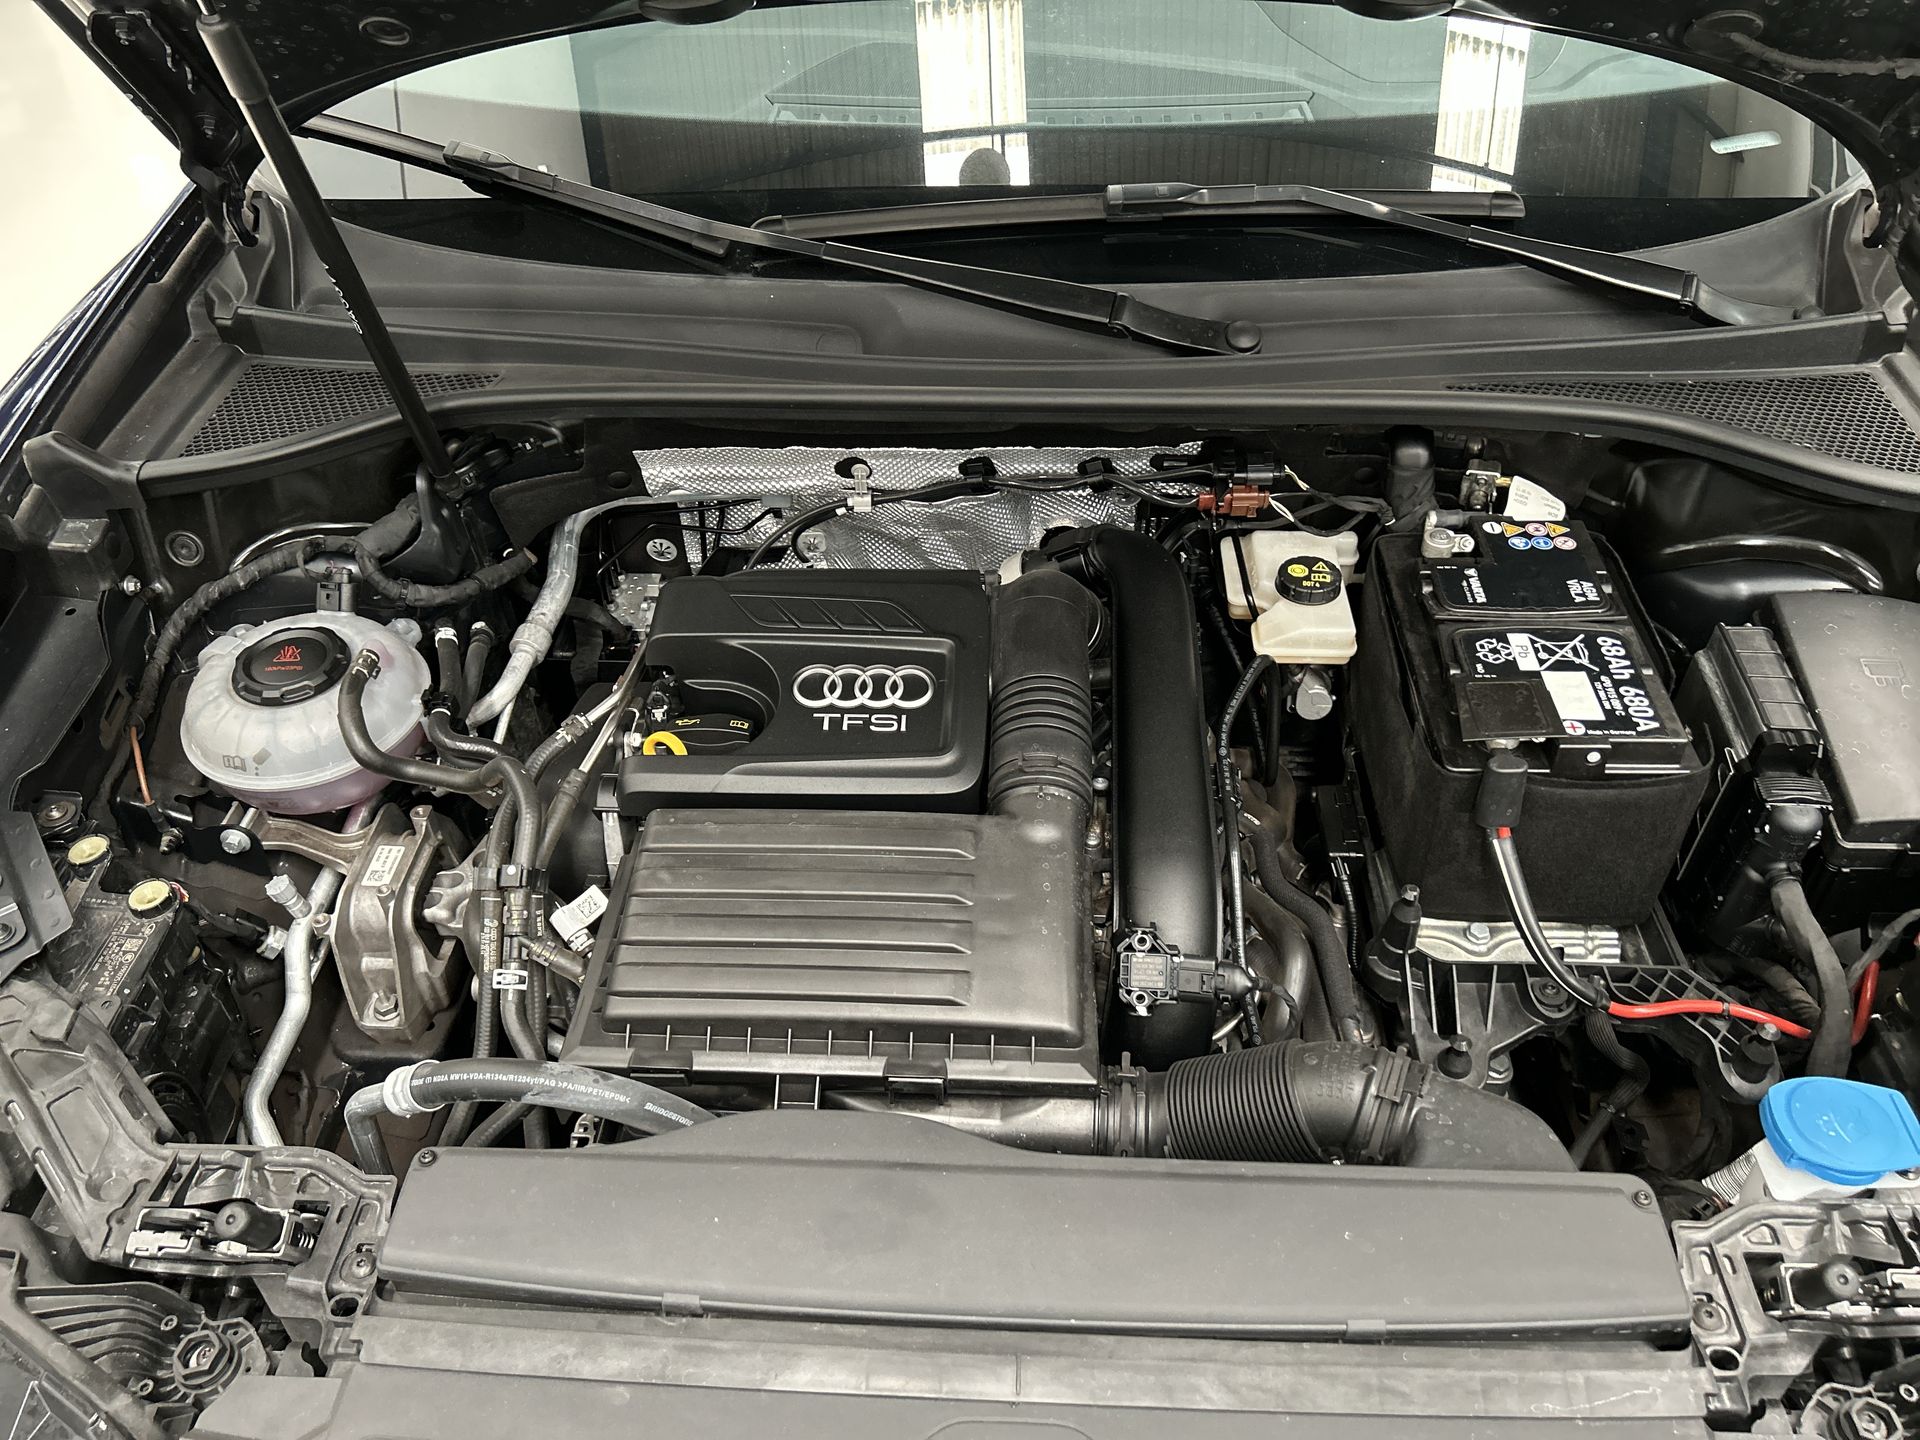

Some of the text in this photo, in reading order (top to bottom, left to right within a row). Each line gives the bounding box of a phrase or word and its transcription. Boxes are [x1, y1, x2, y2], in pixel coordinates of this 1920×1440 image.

[1469, 576, 1487, 603] VARTA
[1566, 579, 1586, 603] VRLA
[1580, 580, 1600, 601] AGM
[1515, 645, 1530, 658] Pb
[1596, 636, 1660, 732] 68Ah 680A
[812, 713, 907, 732] TFSI
[644, 1102, 695, 1127] BRIDGESTONE
